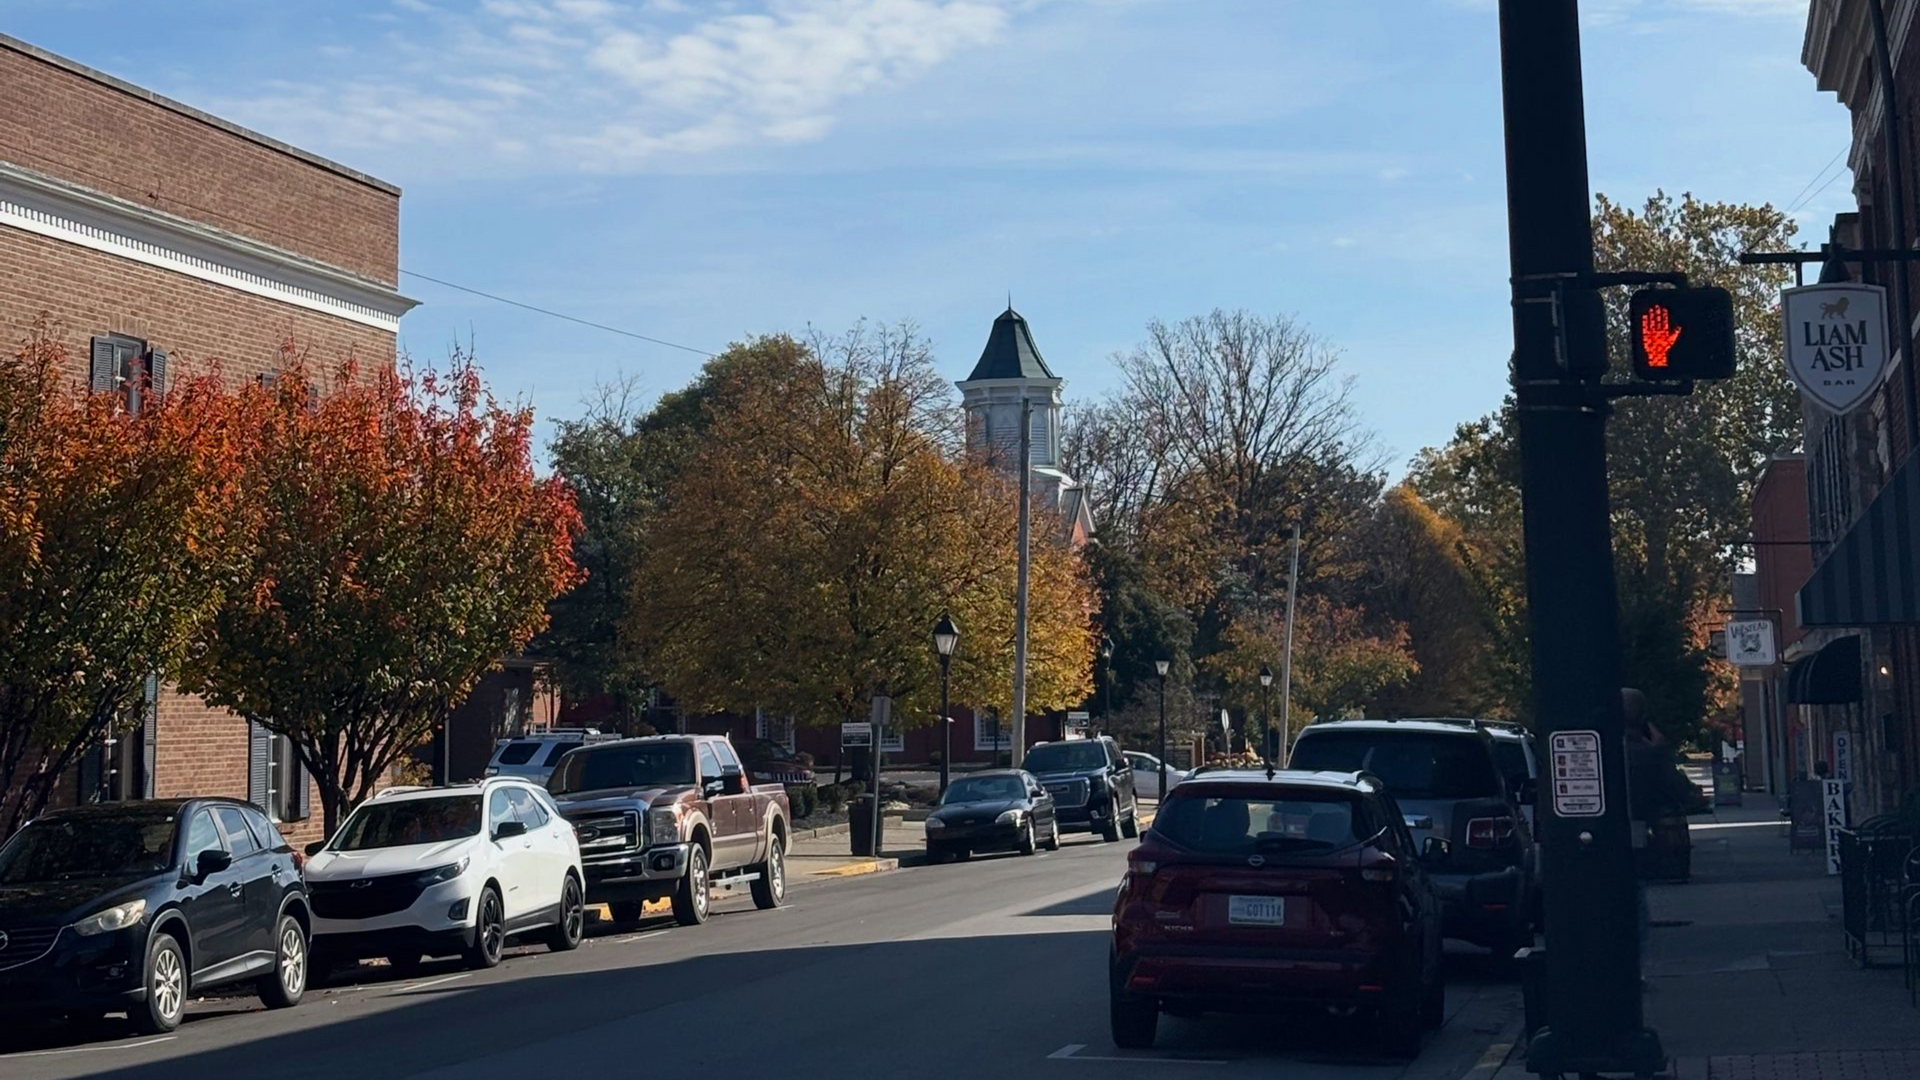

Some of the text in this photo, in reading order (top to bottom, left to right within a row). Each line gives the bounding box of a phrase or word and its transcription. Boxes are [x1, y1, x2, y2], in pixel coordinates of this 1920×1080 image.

[1803, 320, 1868, 346] LIAM
[1811, 345, 1865, 371] ASH
[1837, 737, 1847, 780] OPEN
